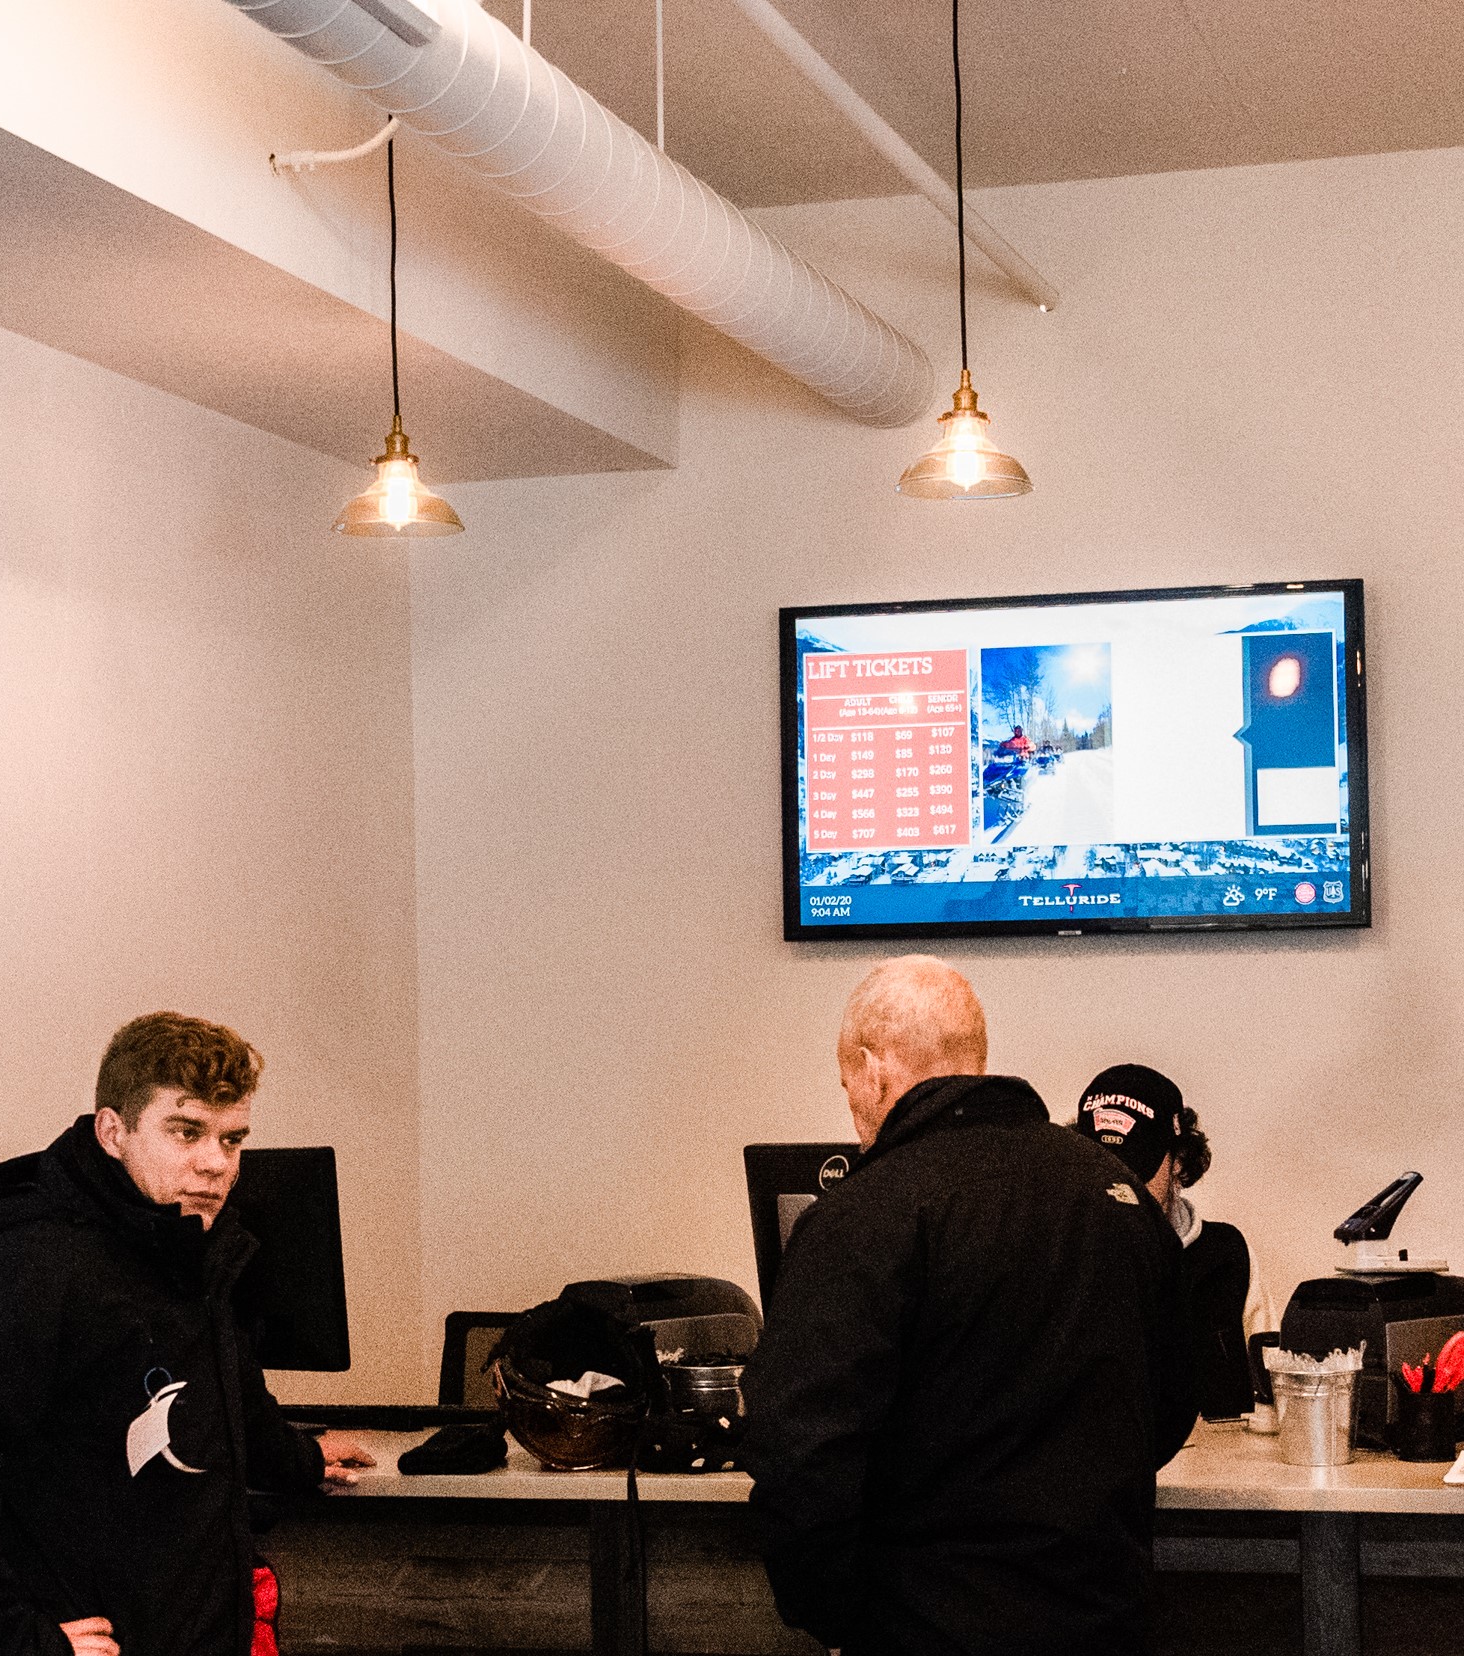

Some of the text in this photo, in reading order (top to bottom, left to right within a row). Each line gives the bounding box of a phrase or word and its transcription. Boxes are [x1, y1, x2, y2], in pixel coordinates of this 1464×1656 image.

[807, 656, 933, 679] LIFT TICKETS
[813, 792, 819, 801] 3
[813, 810, 819, 819] 4
[814, 830, 820, 839] 5
[809, 895, 852, 907] 01/02/20
[1018, 893, 1121, 907] TELLURIDE
[811, 906, 850, 918] 9:04 AM
[1083, 1094, 1155, 1119] CHAMPIONS
